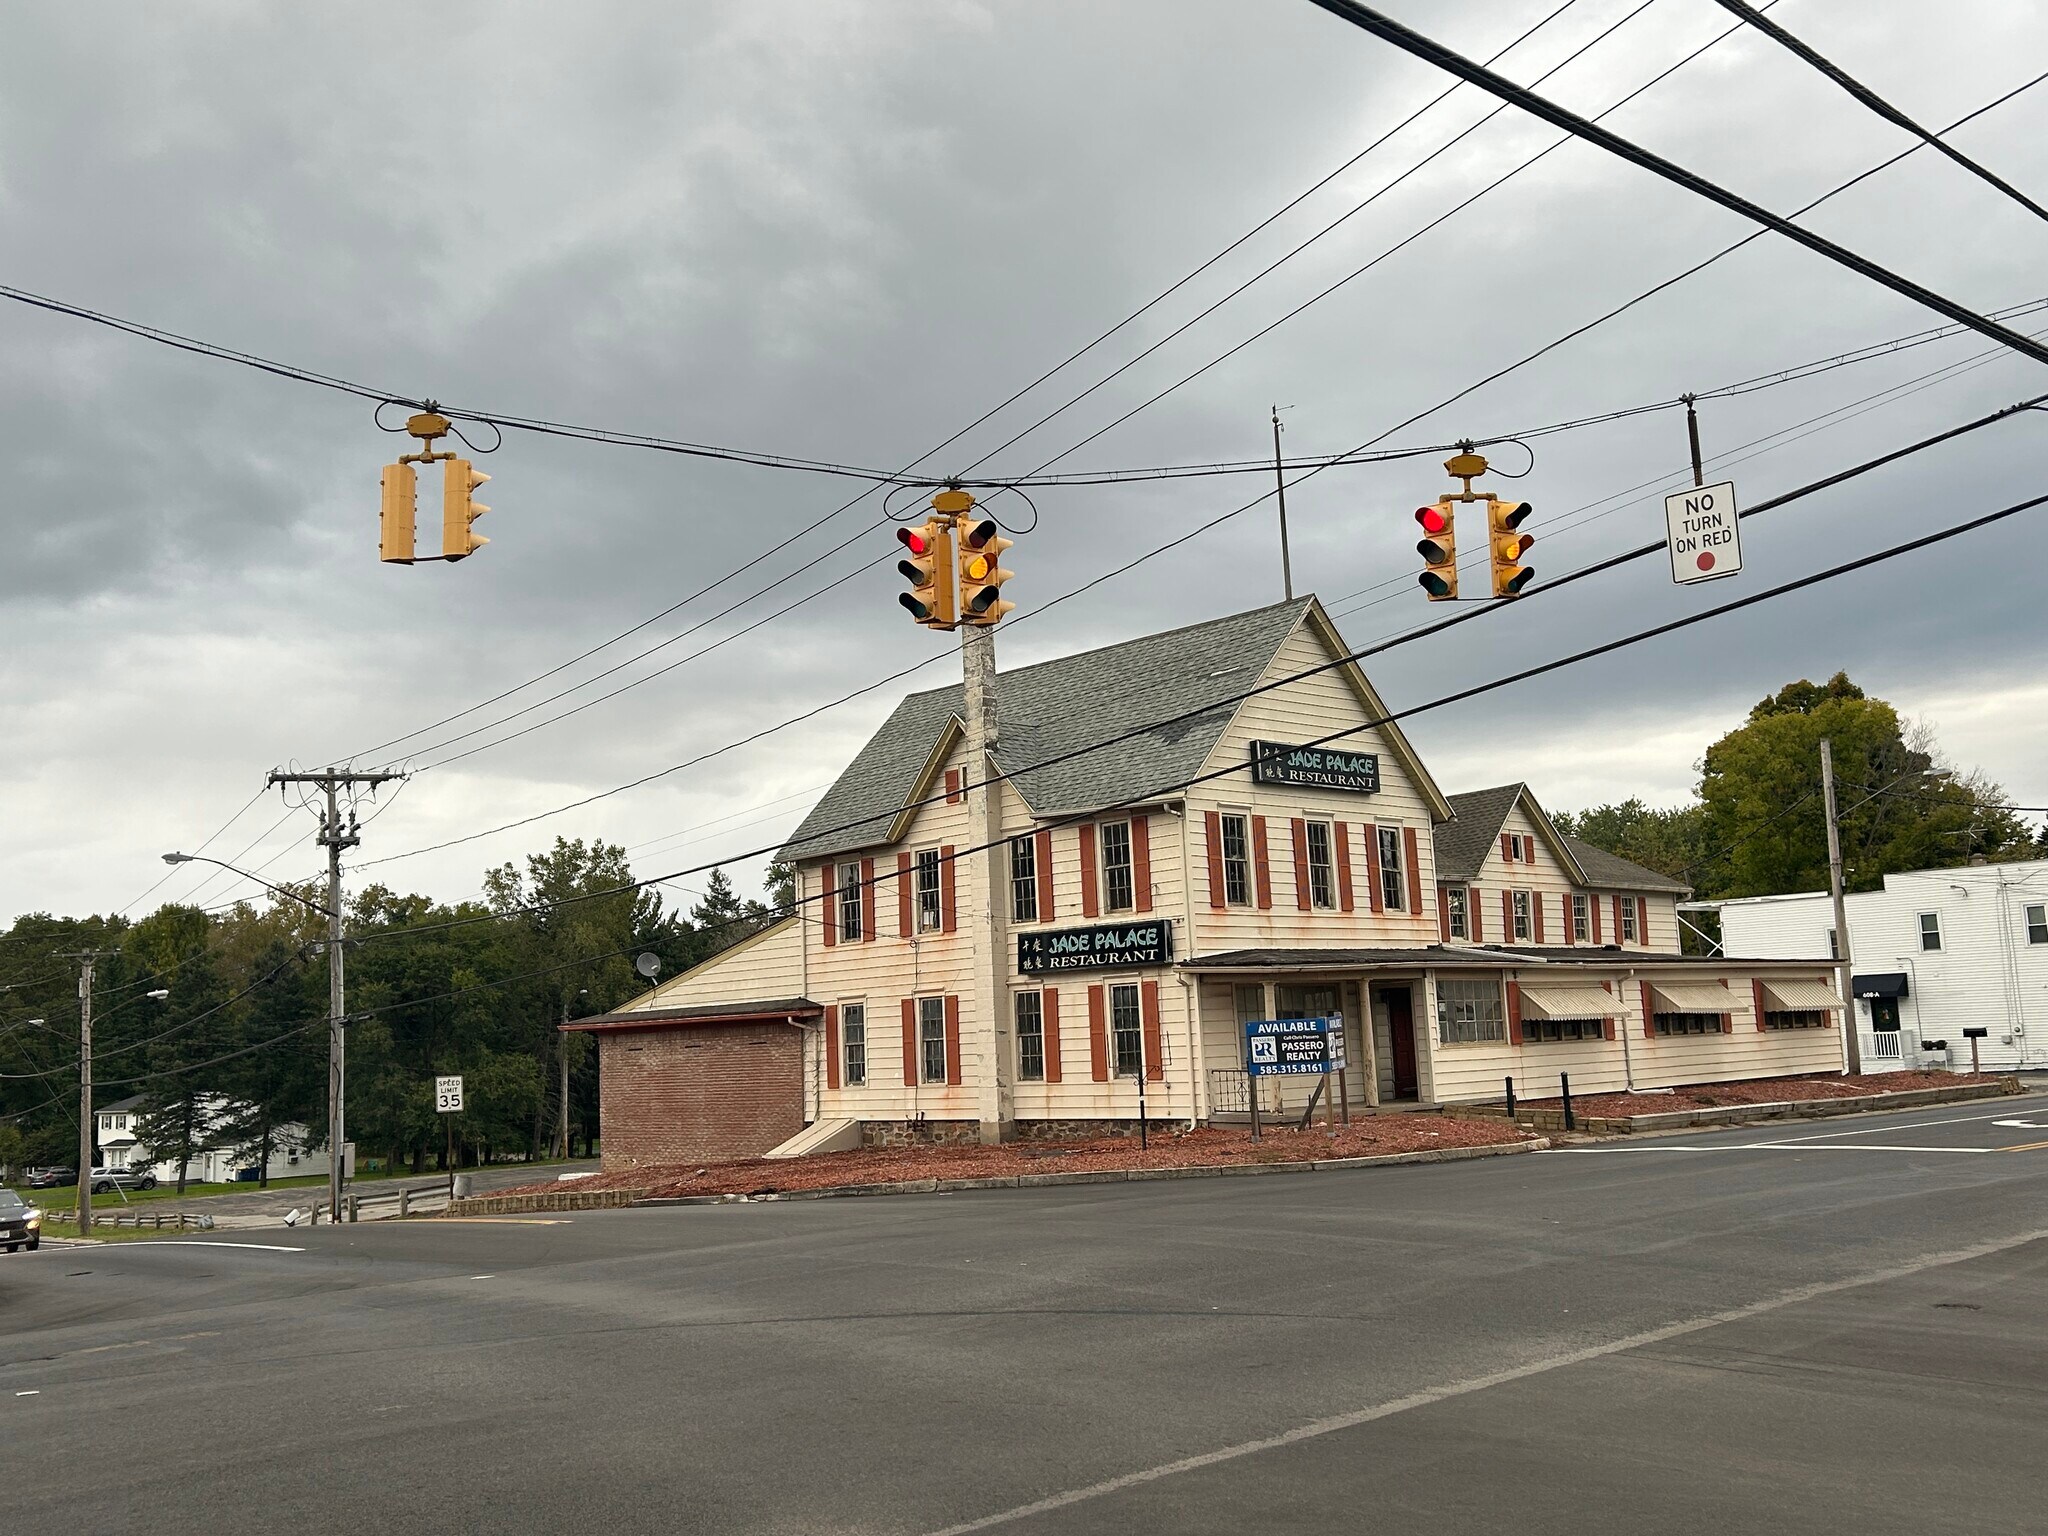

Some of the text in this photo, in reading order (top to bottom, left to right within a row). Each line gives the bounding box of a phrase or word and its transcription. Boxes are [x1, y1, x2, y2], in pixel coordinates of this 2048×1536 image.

[1685, 494, 1714, 515] NO
[1682, 513, 1722, 534] TURN
[1676, 529, 1732, 553] ON RED
[1287, 750, 1374, 775] JADE PALACE
[1289, 769, 1375, 788] RESTAURANT
[1049, 928, 1158, 954] JADE PALACE
[1050, 949, 1159, 969] RESTAURANT
[1258, 1021, 1317, 1034] AVAILABLE
[1281, 1041, 1324, 1052] PASSERO
[1286, 1051, 1321, 1062] REALTY
[1260, 1064, 1322, 1076] 585.315.8161
[439, 1094, 460, 1107] 35
